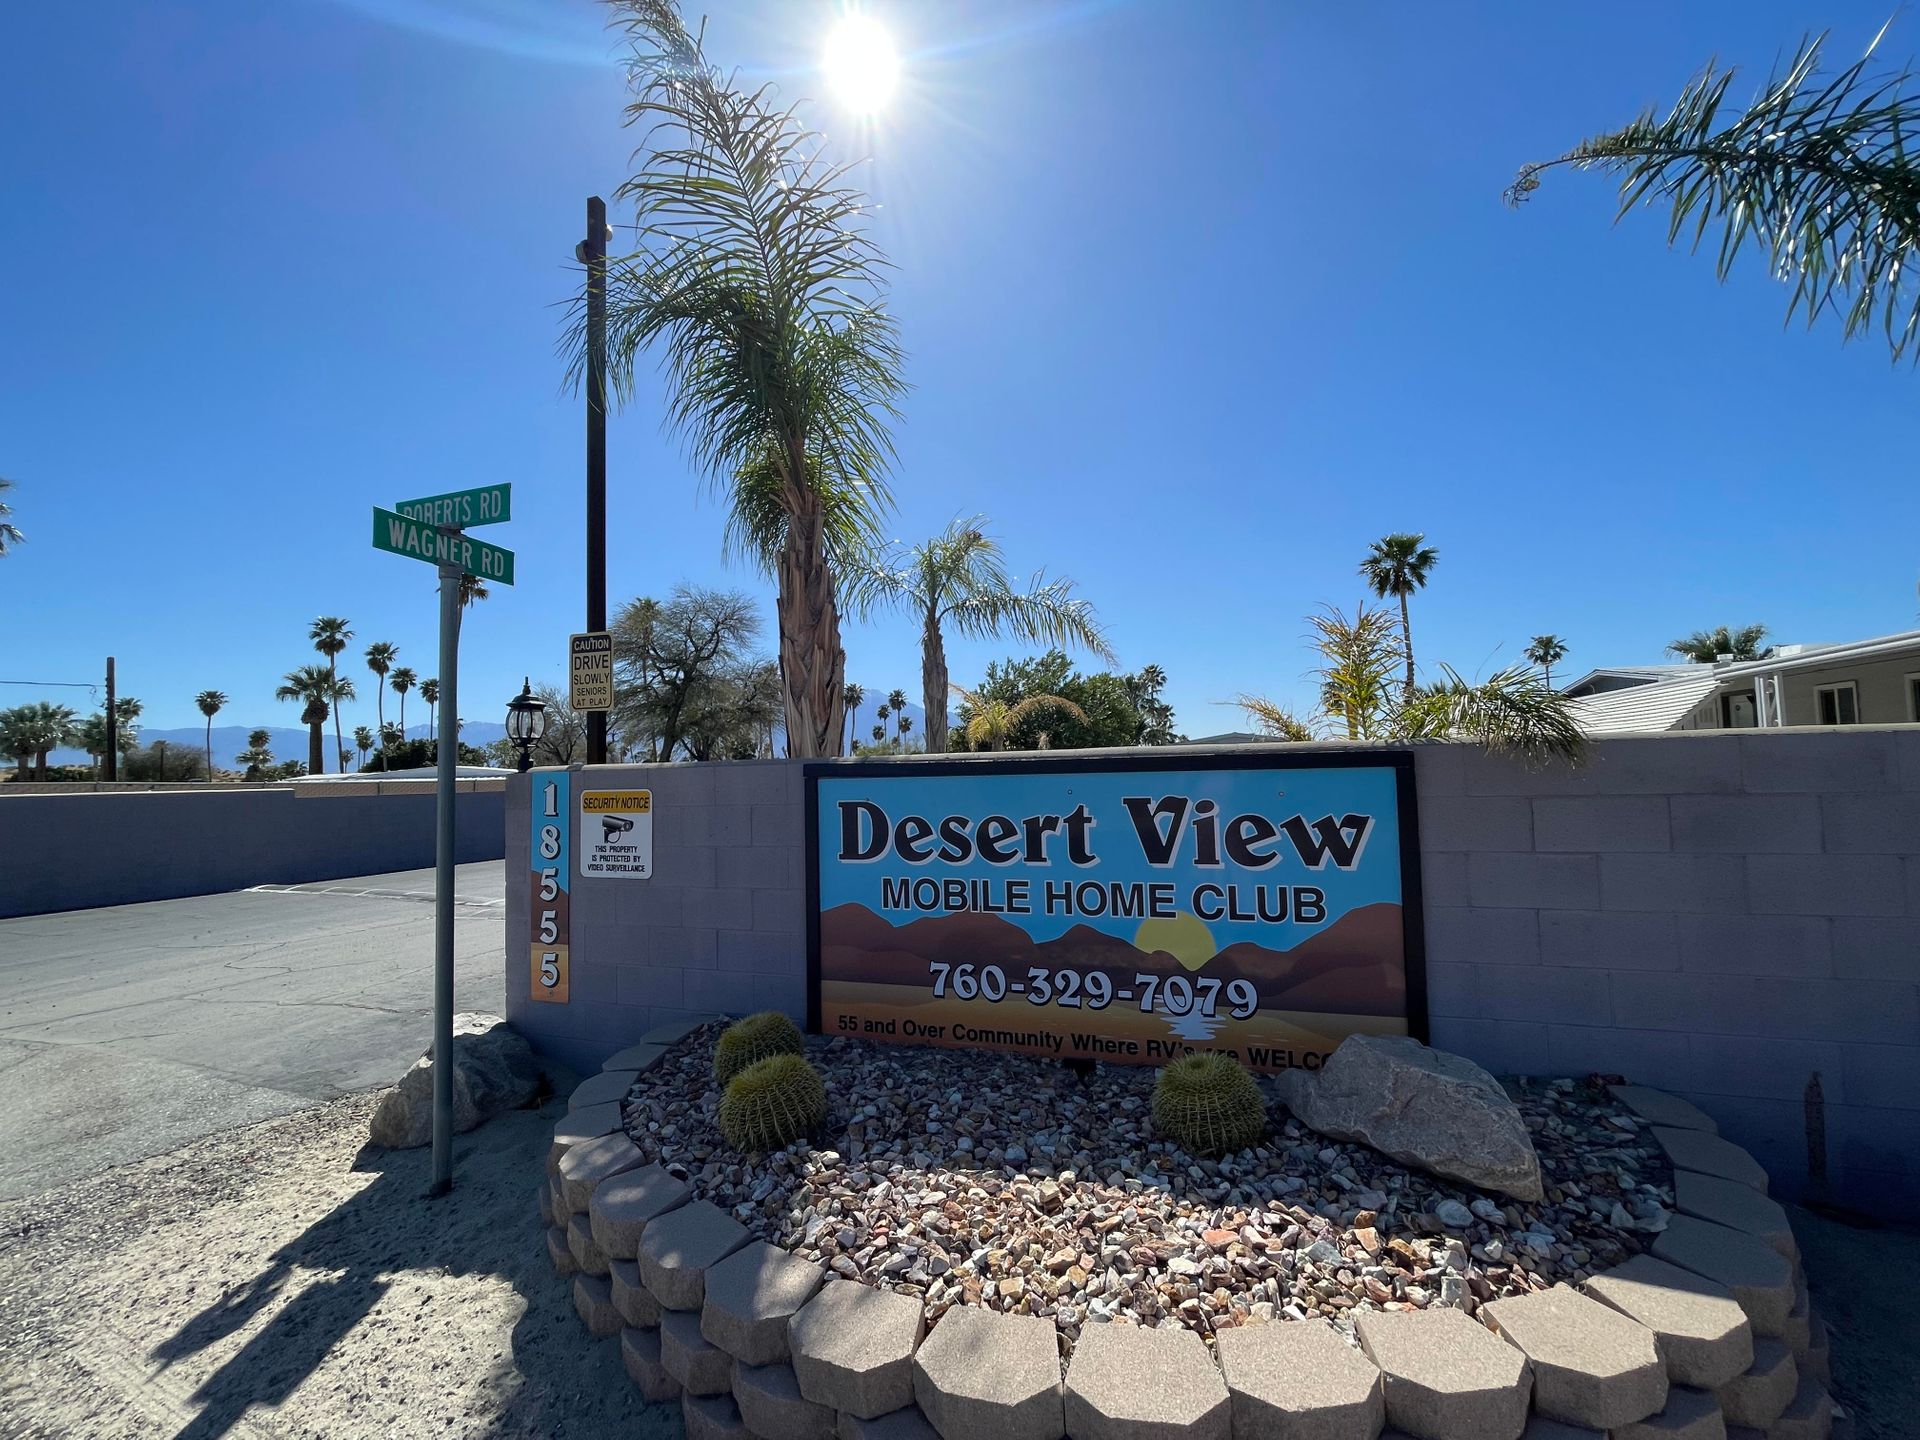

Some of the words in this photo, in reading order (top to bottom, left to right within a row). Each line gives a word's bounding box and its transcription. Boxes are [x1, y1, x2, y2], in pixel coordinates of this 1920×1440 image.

[480, 490, 501, 519] RD
[388, 518, 473, 569] WAGNER
[481, 548, 505, 577] RD
[574, 639, 609, 651] CAUTION
[574, 654, 609, 671] DRIVE
[573, 672, 610, 685] SLOWLY
[576, 686, 607, 697] SENIORS
[576, 698, 586, 706] AT
[589, 698, 607, 706] PLAY
[583, 796, 620, 809] SECURITY
[621, 796, 650, 809] NOTICE
[837, 800, 1100, 868] Desert
[1121, 795, 1375, 872] View
[595, 845, 607, 853] THIS
[609, 845, 638, 854] PROPERTY
[591, 854, 598, 862] IS
[599, 855, 631, 863] PROTECTED
[587, 863, 604, 871] VIDEO
[605, 864, 645, 873] SURVEILLANCE
[540, 783, 560, 989] 18555
[881, 876, 1032, 916] MOBILE
[1044, 880, 1178, 920] HOME
[1191, 883, 1328, 925] CLUB
[929, 960, 1259, 1021] 760-329-7079
[838, 1015, 858, 1031] 55
[863, 1018, 896, 1035] and
[902, 1020, 946, 1039] Over
[952, 1024, 1063, 1052] Community
[1071, 1033, 1138, 1056] Where
